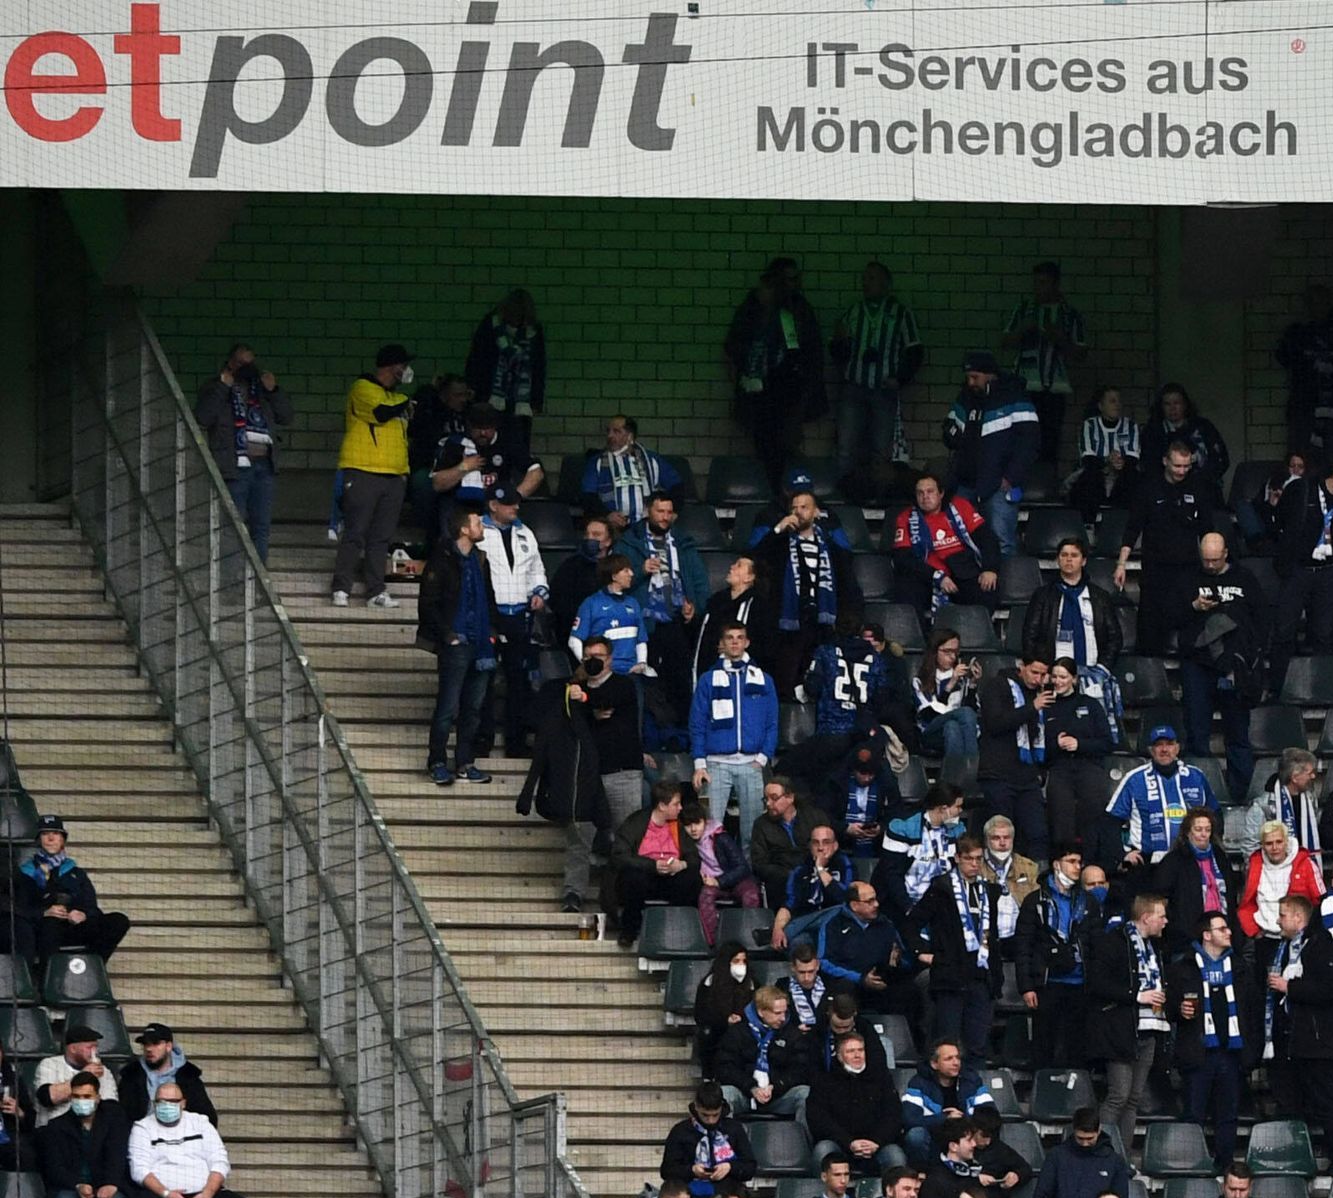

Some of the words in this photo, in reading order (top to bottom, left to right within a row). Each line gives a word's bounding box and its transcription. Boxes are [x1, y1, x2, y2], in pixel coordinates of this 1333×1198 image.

[805, 41, 1127, 95] IT-Services
[1147, 54, 1249, 95] aus
[756, 105, 1298, 168] Mönchengladbach
